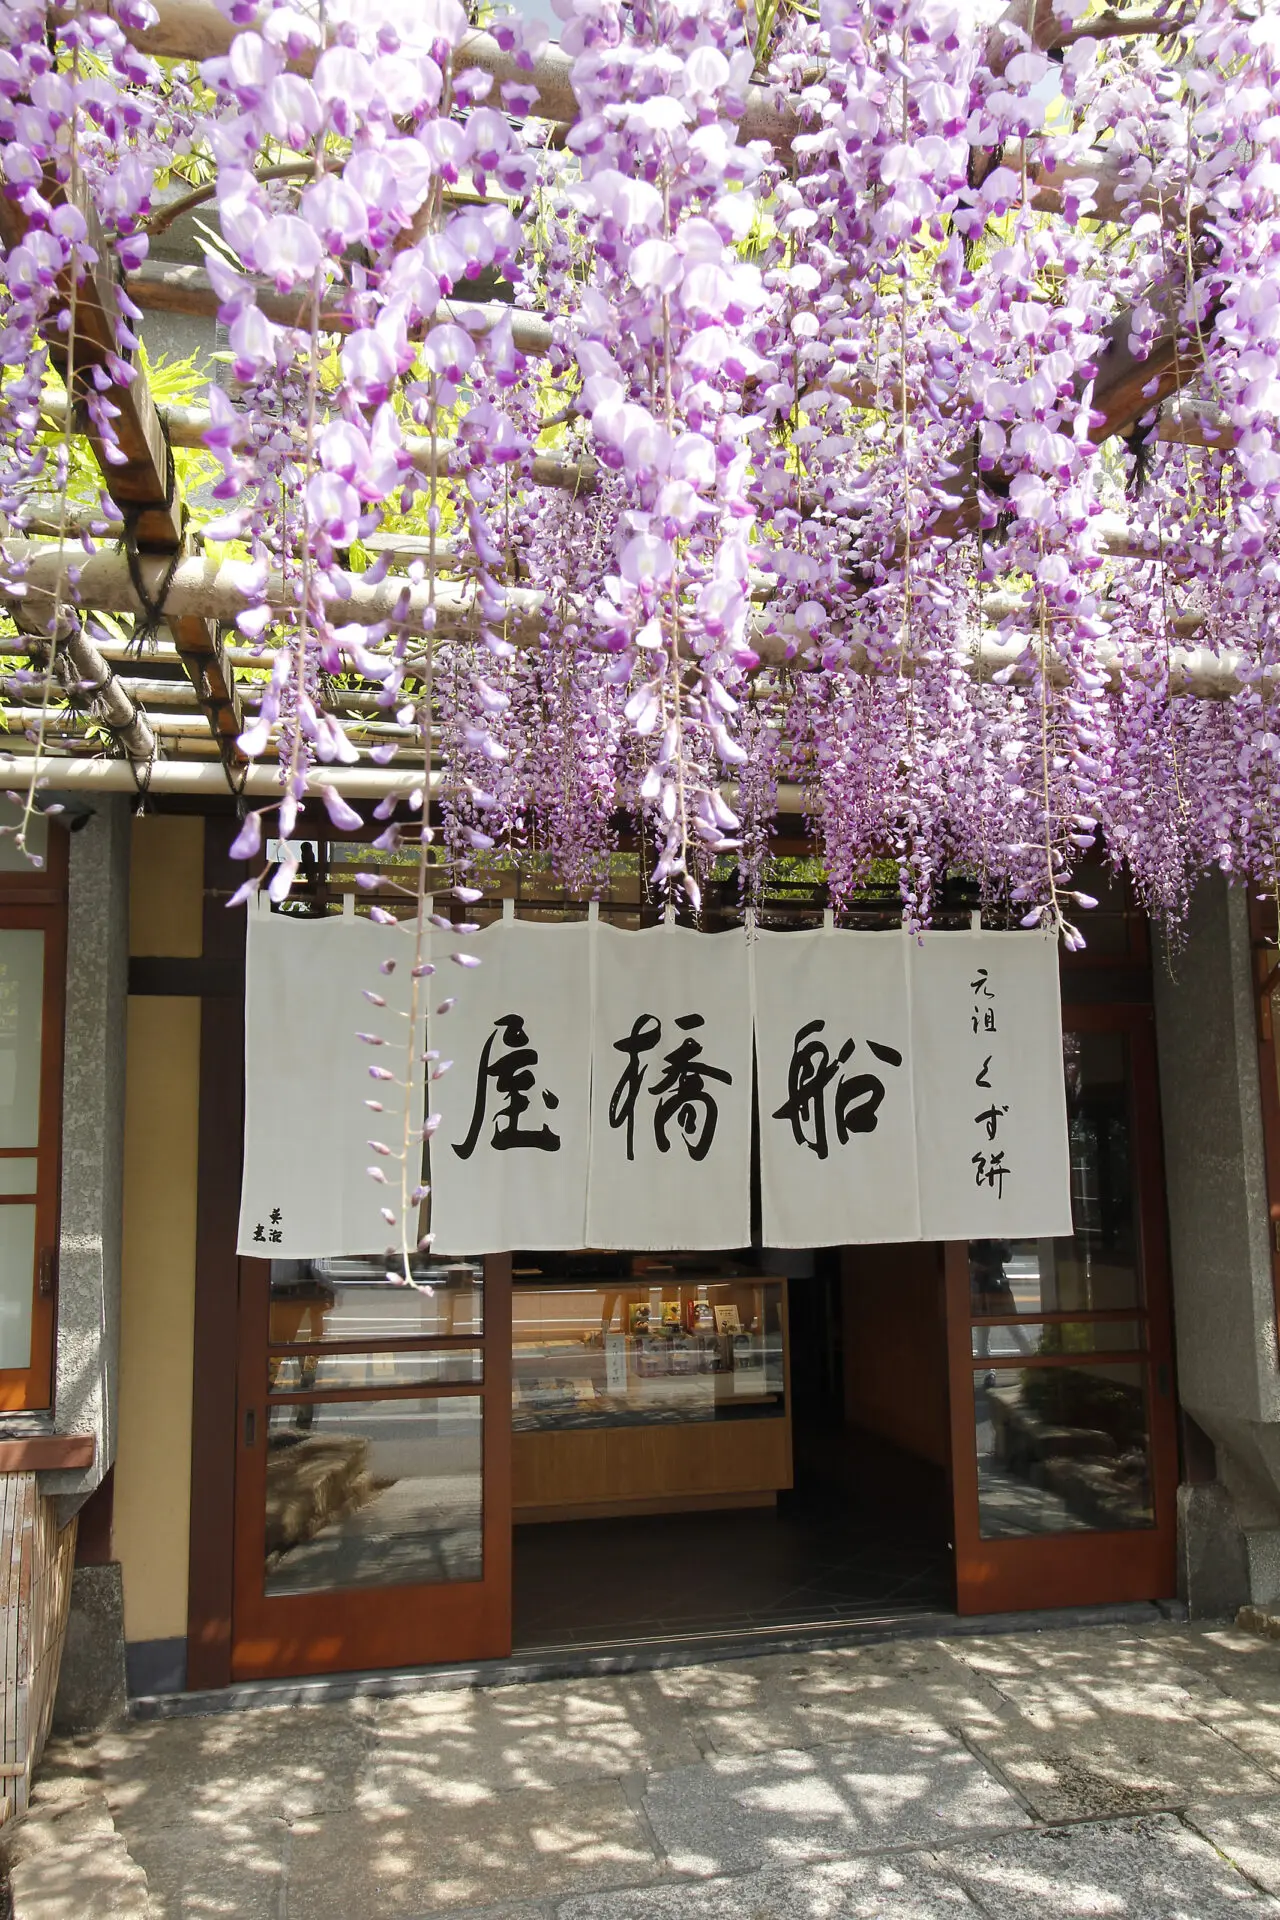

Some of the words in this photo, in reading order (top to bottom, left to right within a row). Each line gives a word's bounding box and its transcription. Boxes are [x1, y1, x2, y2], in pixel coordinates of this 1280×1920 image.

[970, 968, 1011, 1200] 元祖くず餅
